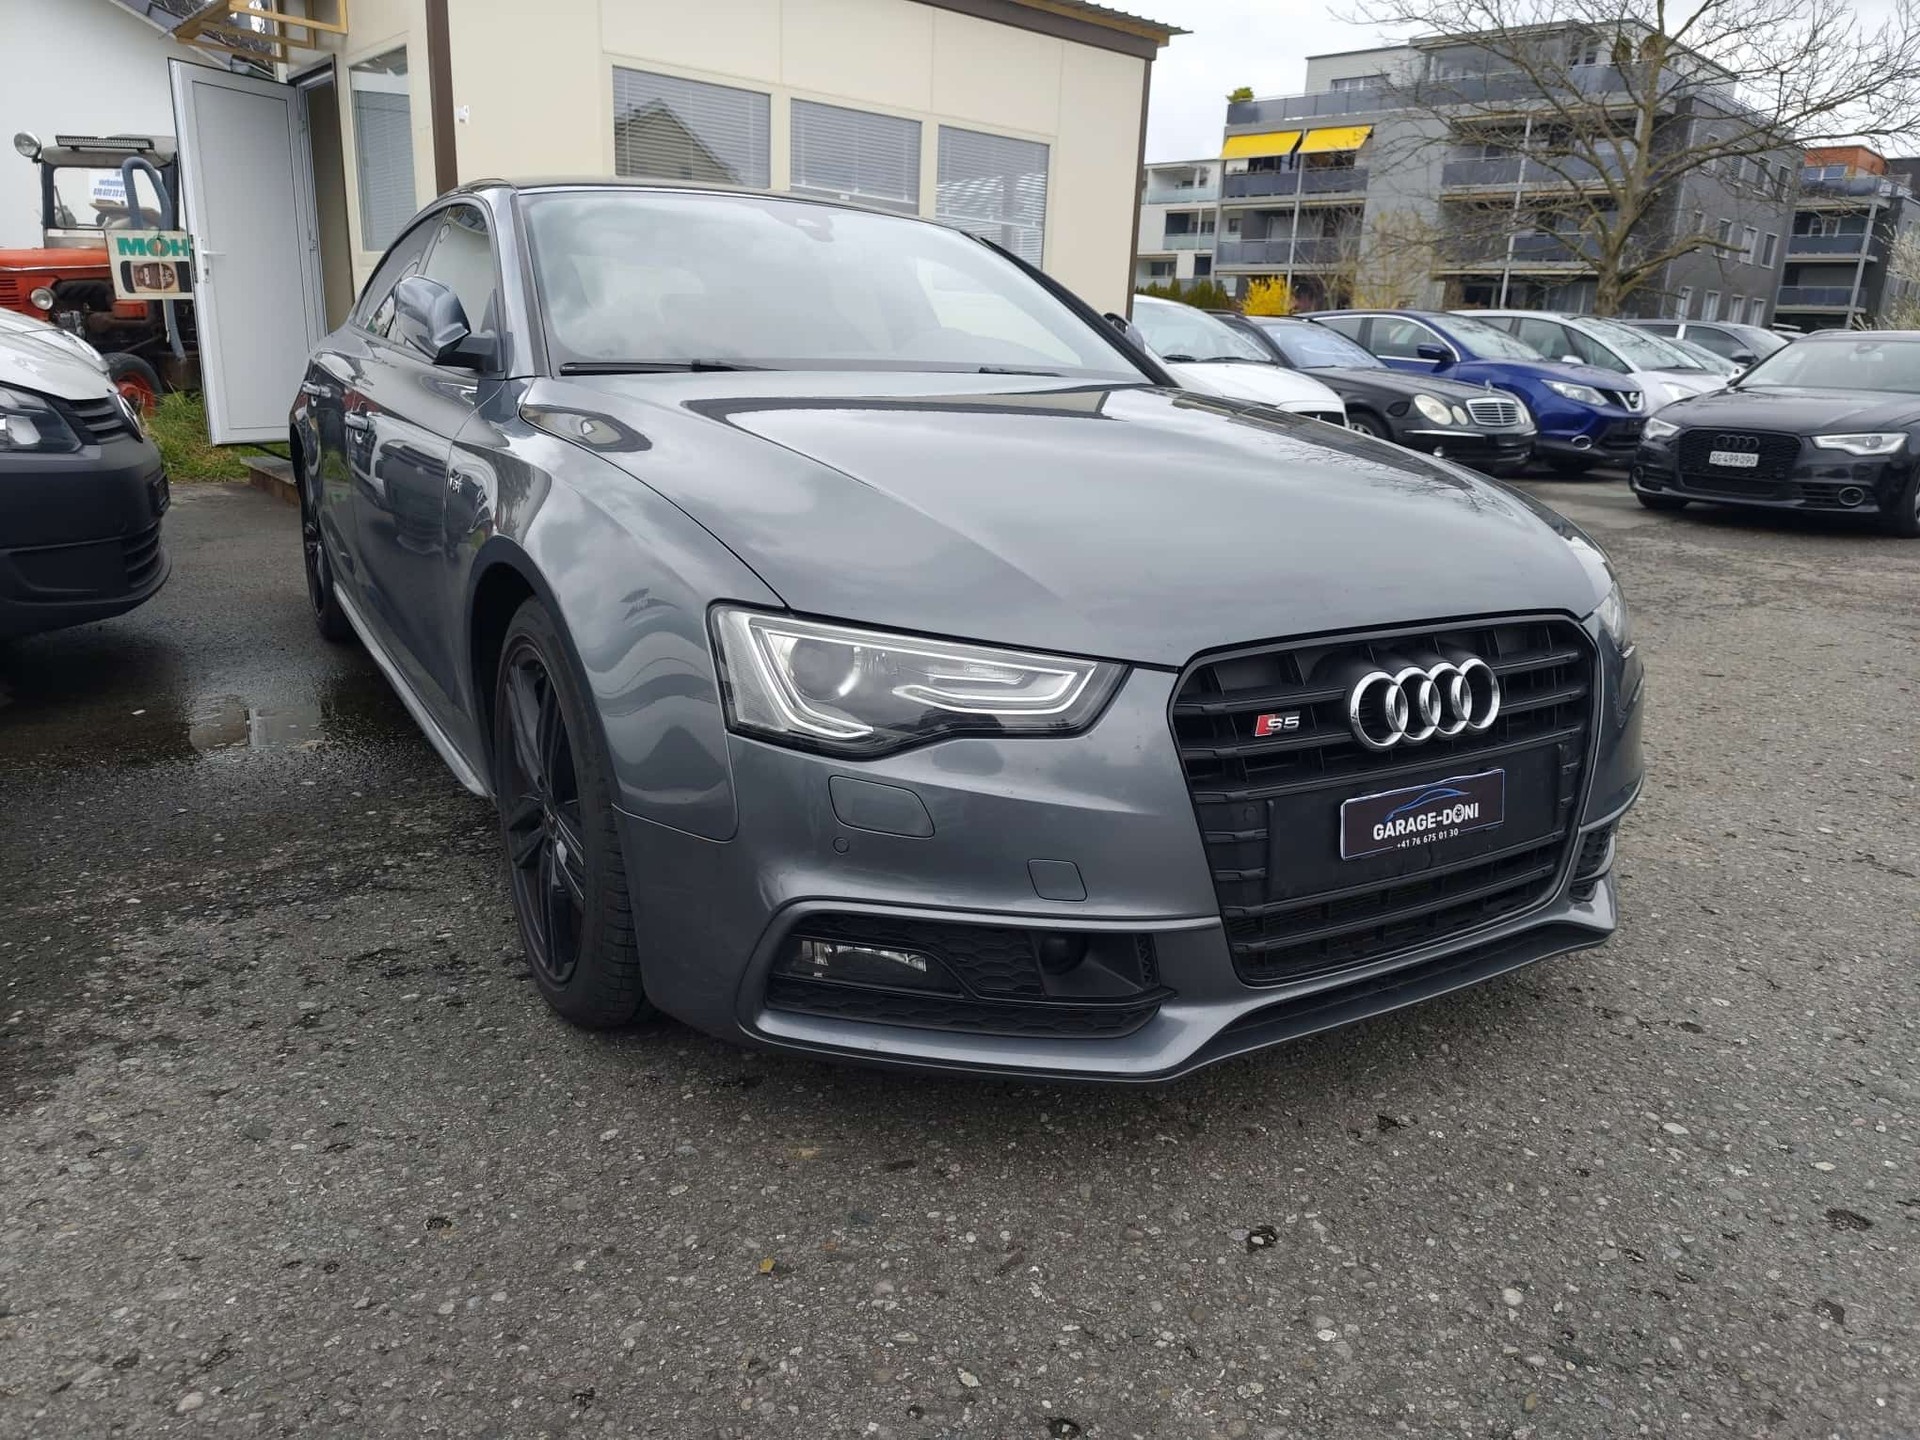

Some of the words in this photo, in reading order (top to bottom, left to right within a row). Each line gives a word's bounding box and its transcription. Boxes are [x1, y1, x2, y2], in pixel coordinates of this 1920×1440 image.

[1265, 715, 1300, 731] S5
[1373, 802, 1479, 841] GARAGE-DONI
[1397, 839, 1410, 849] +41
[1412, 836, 1421, 846] 76
[1423, 833, 1437, 843] 675
[1438, 831, 1448, 840] 01
[1449, 827, 1459, 837] 30
